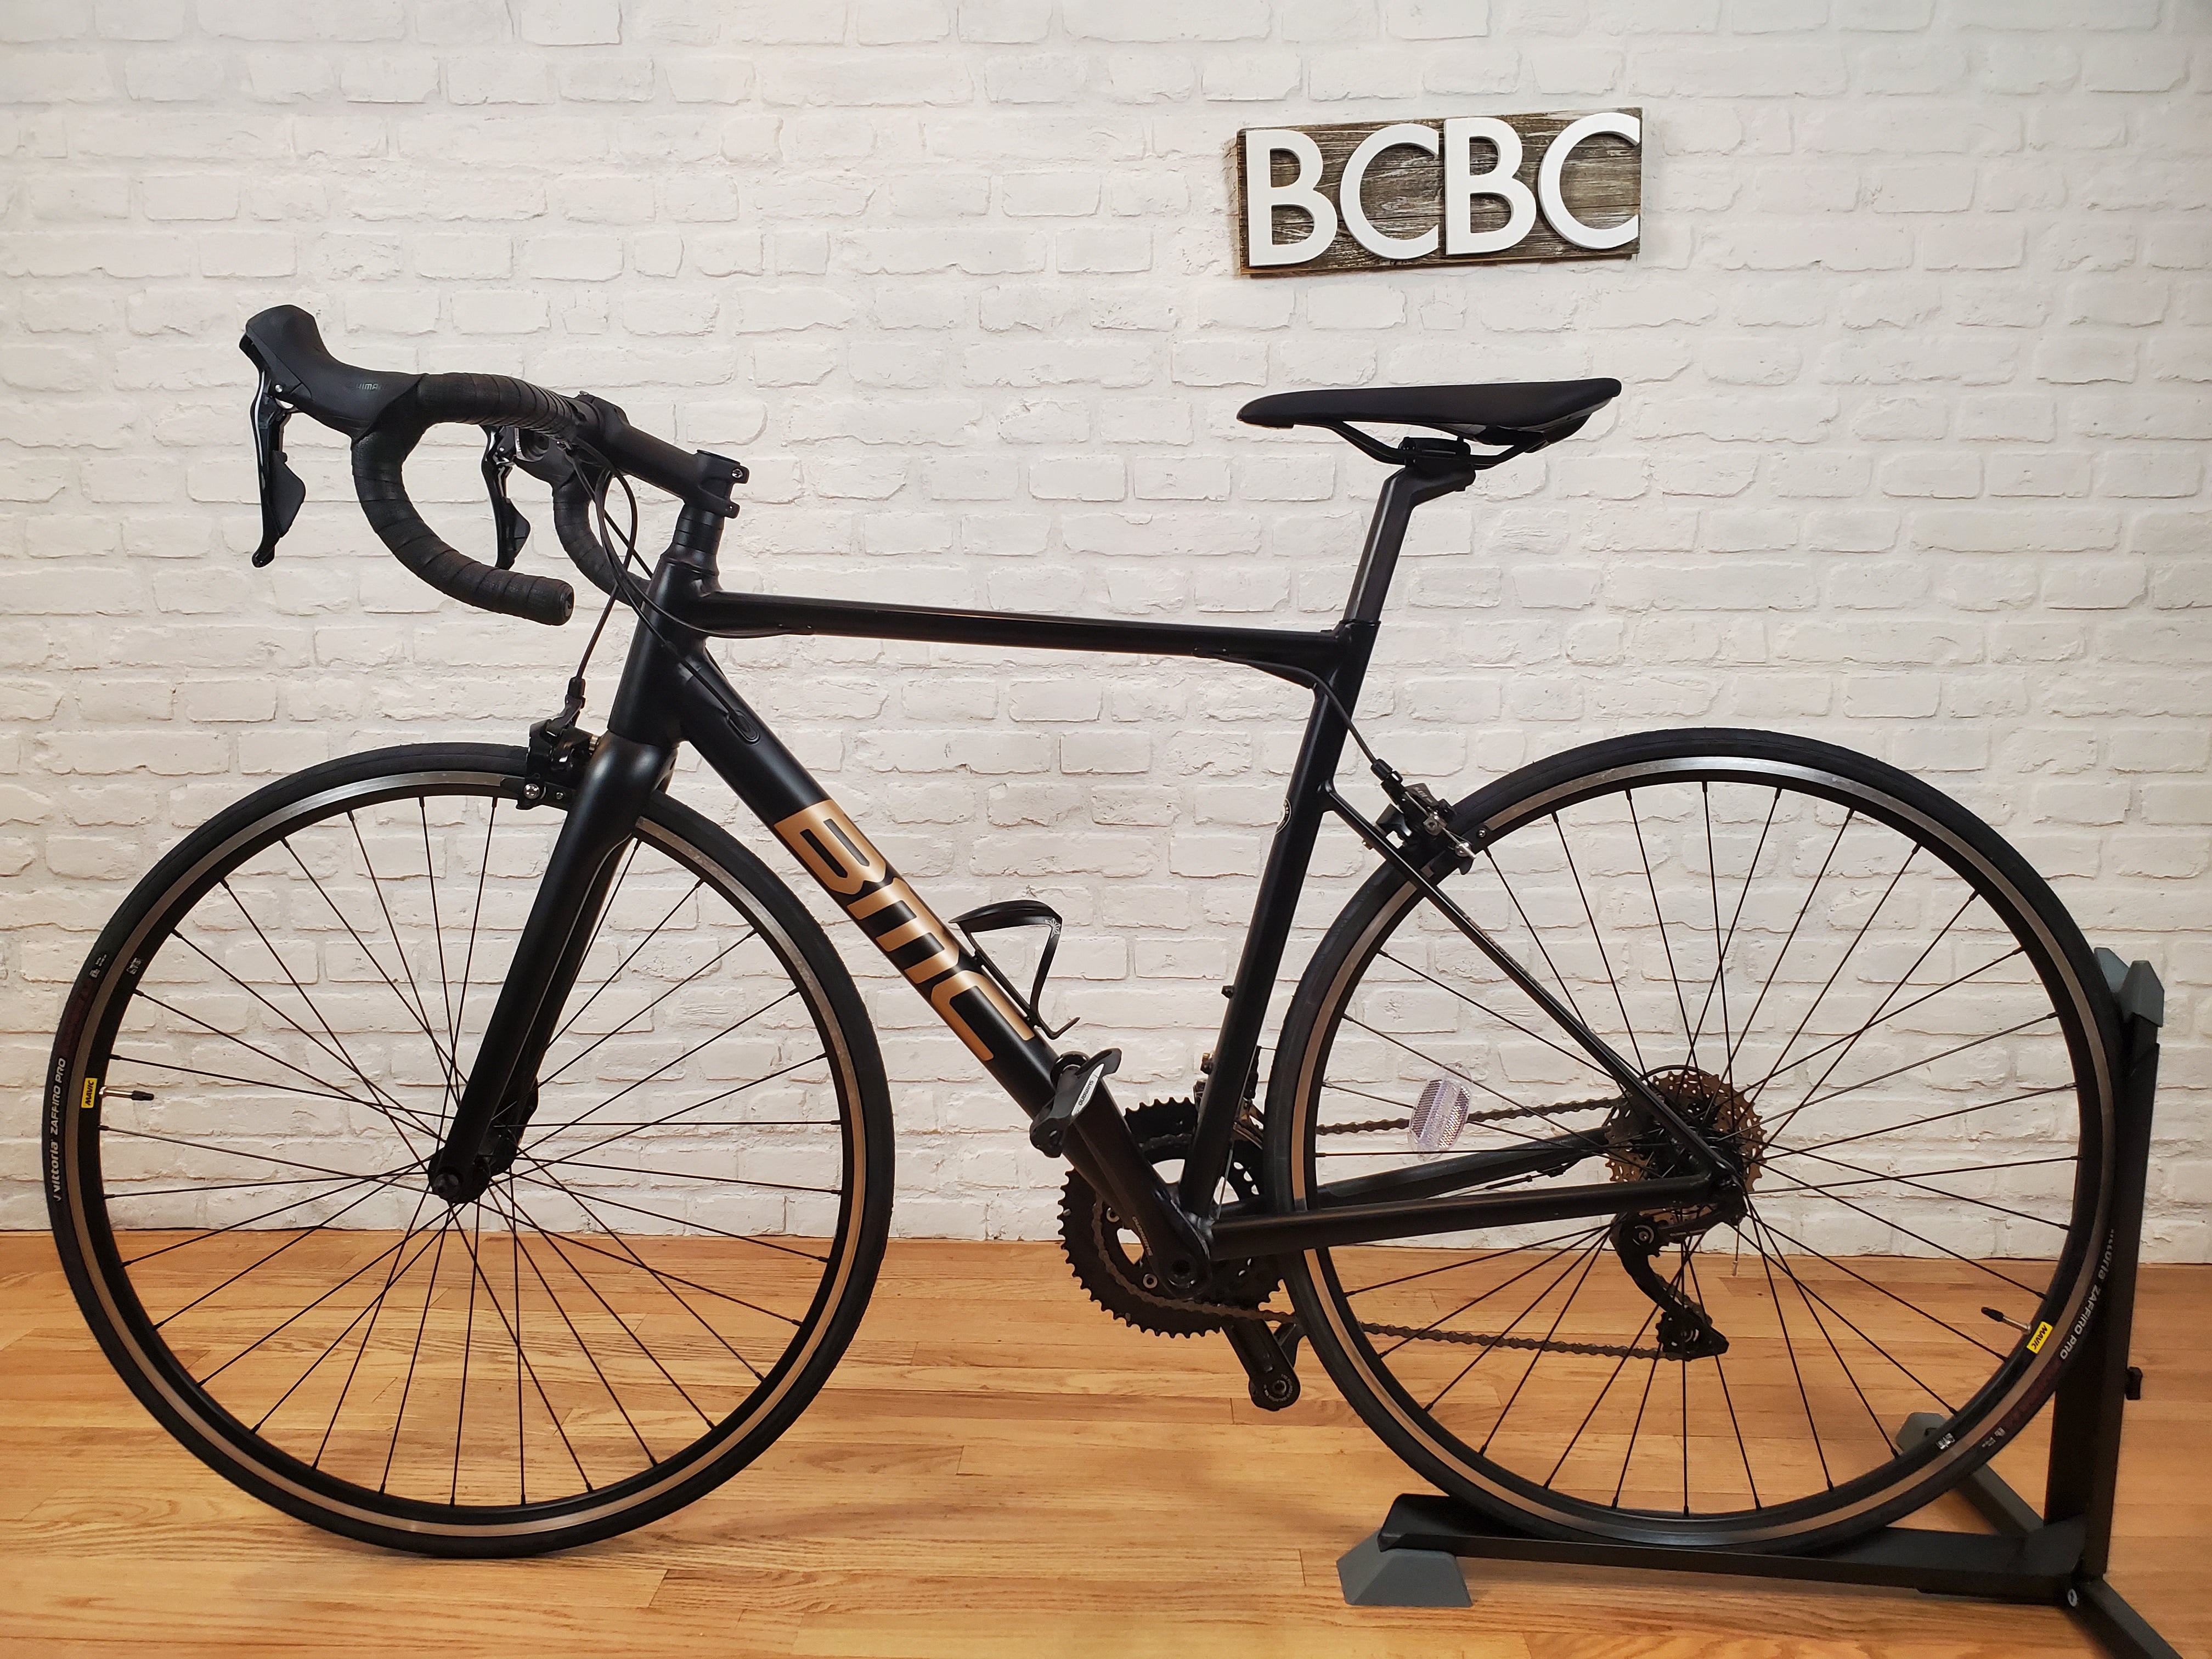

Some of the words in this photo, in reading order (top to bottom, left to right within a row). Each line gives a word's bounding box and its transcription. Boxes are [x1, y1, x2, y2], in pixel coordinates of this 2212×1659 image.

[1245, 112, 1640, 267] BCBC
[774, 799, 1035, 1061] BMC
[55, 1058, 66, 1084] PRO
[85, 1080, 94, 1105] MAVIC
[50, 1086, 61, 1136] ZAFFIRO
[2031, 1324, 2048, 1350] MAVIC
[2059, 1334, 2078, 1360] PRO
